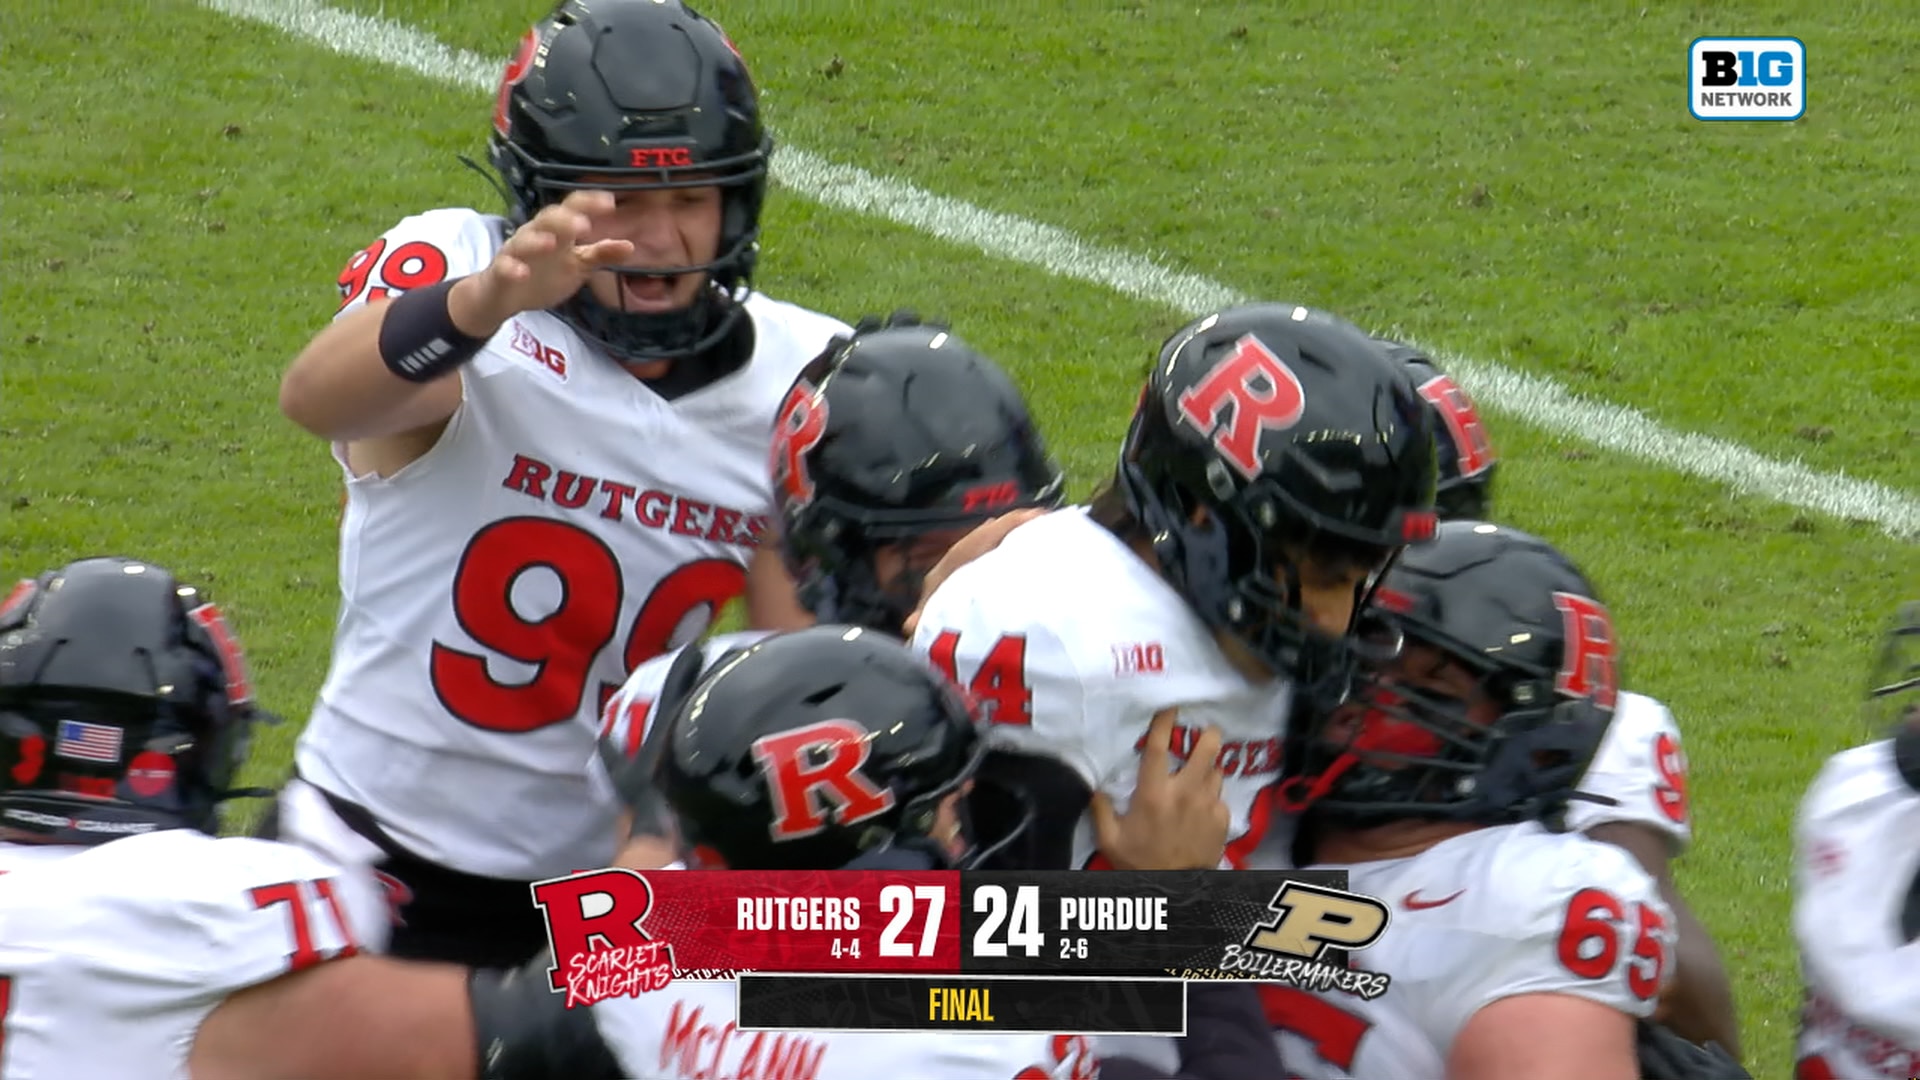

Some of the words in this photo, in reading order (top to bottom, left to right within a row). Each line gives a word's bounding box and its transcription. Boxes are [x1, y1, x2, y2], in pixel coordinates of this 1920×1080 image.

[1177, 331, 1306, 481] R
[502, 453, 768, 547] RUTGERS
[752, 718, 896, 843] R
[1557, 887, 1677, 1000] 65
